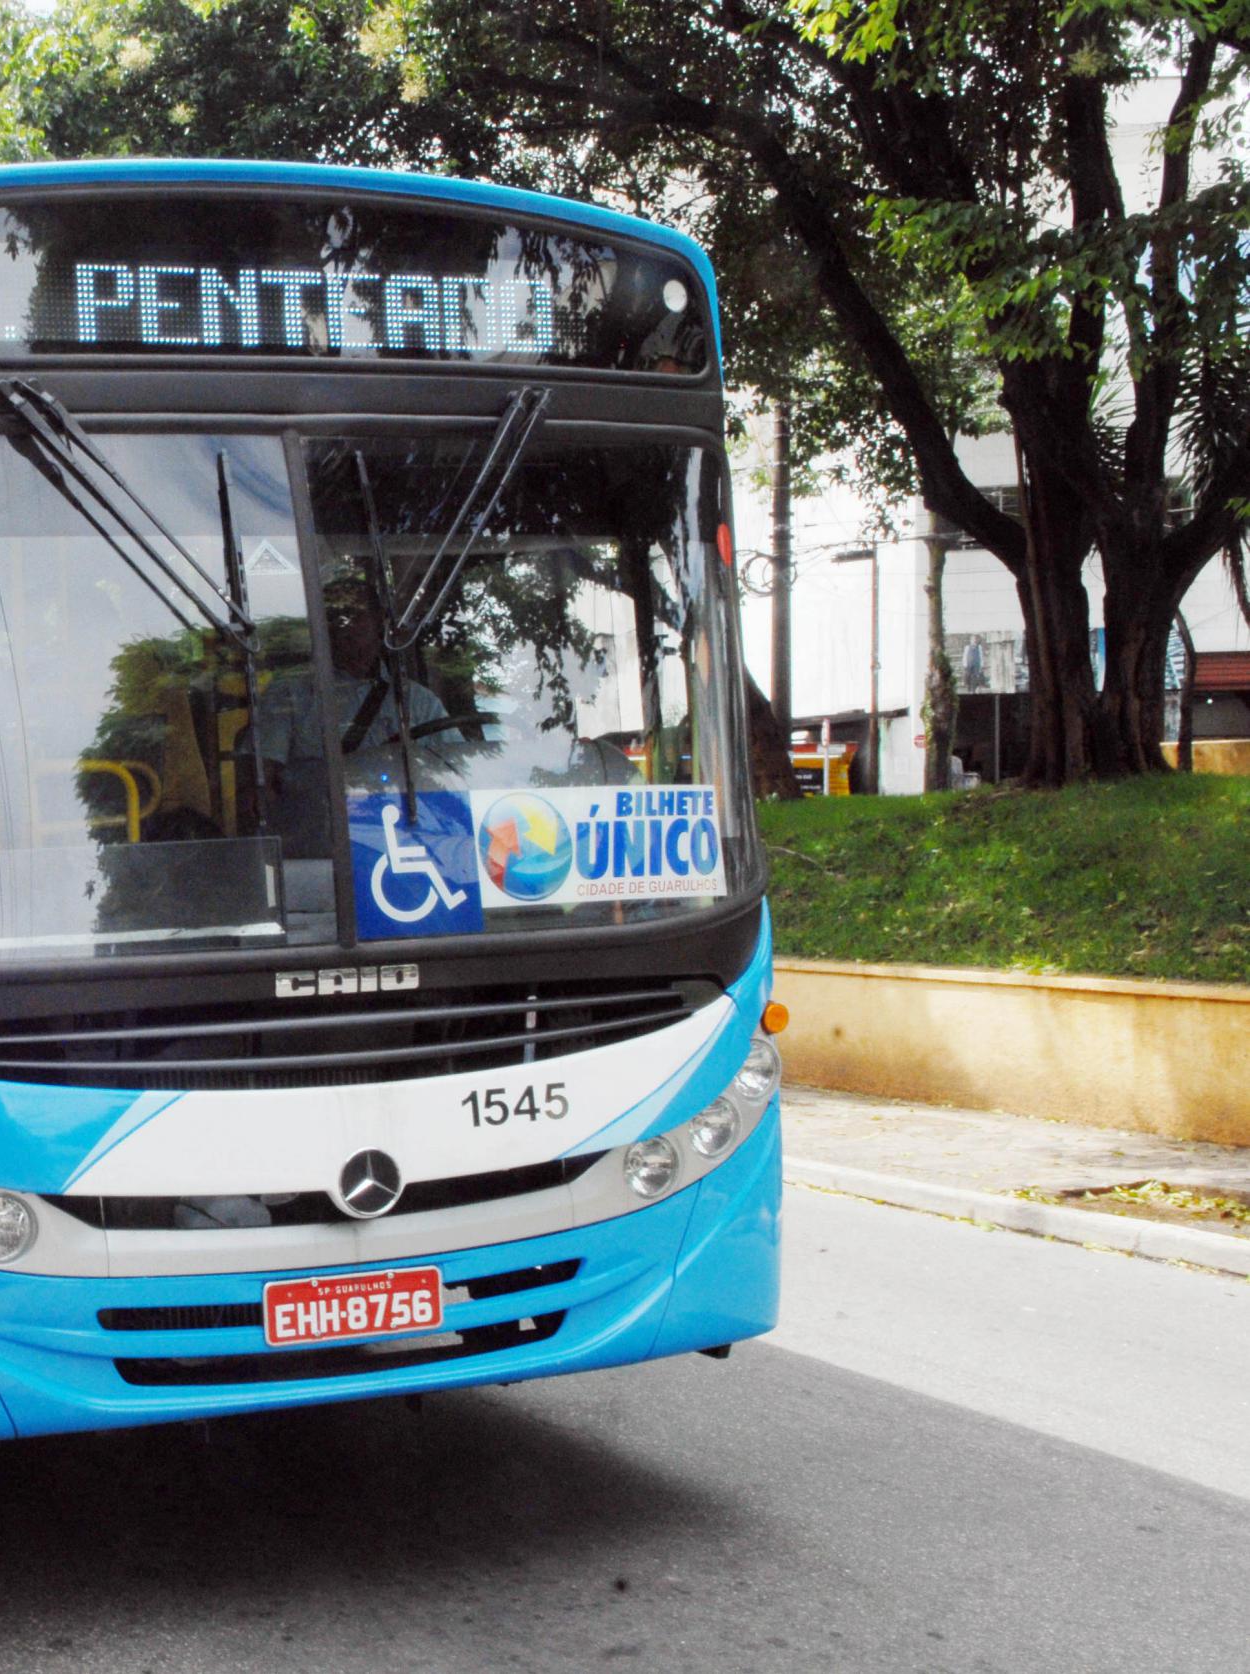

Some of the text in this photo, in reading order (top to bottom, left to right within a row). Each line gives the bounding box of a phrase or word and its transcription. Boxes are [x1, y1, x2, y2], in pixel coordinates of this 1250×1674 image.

[75, 263, 553, 352] PENTEADO
[615, 790, 714, 817] BILHETE
[576, 804, 718, 880] ÚNICO
[576, 879, 718, 896] CIDADE DE GUARULHOS
[275, 963, 420, 998] CAIO
[461, 1082, 570, 1128] 1545
[317, 1287, 330, 1295] SP
